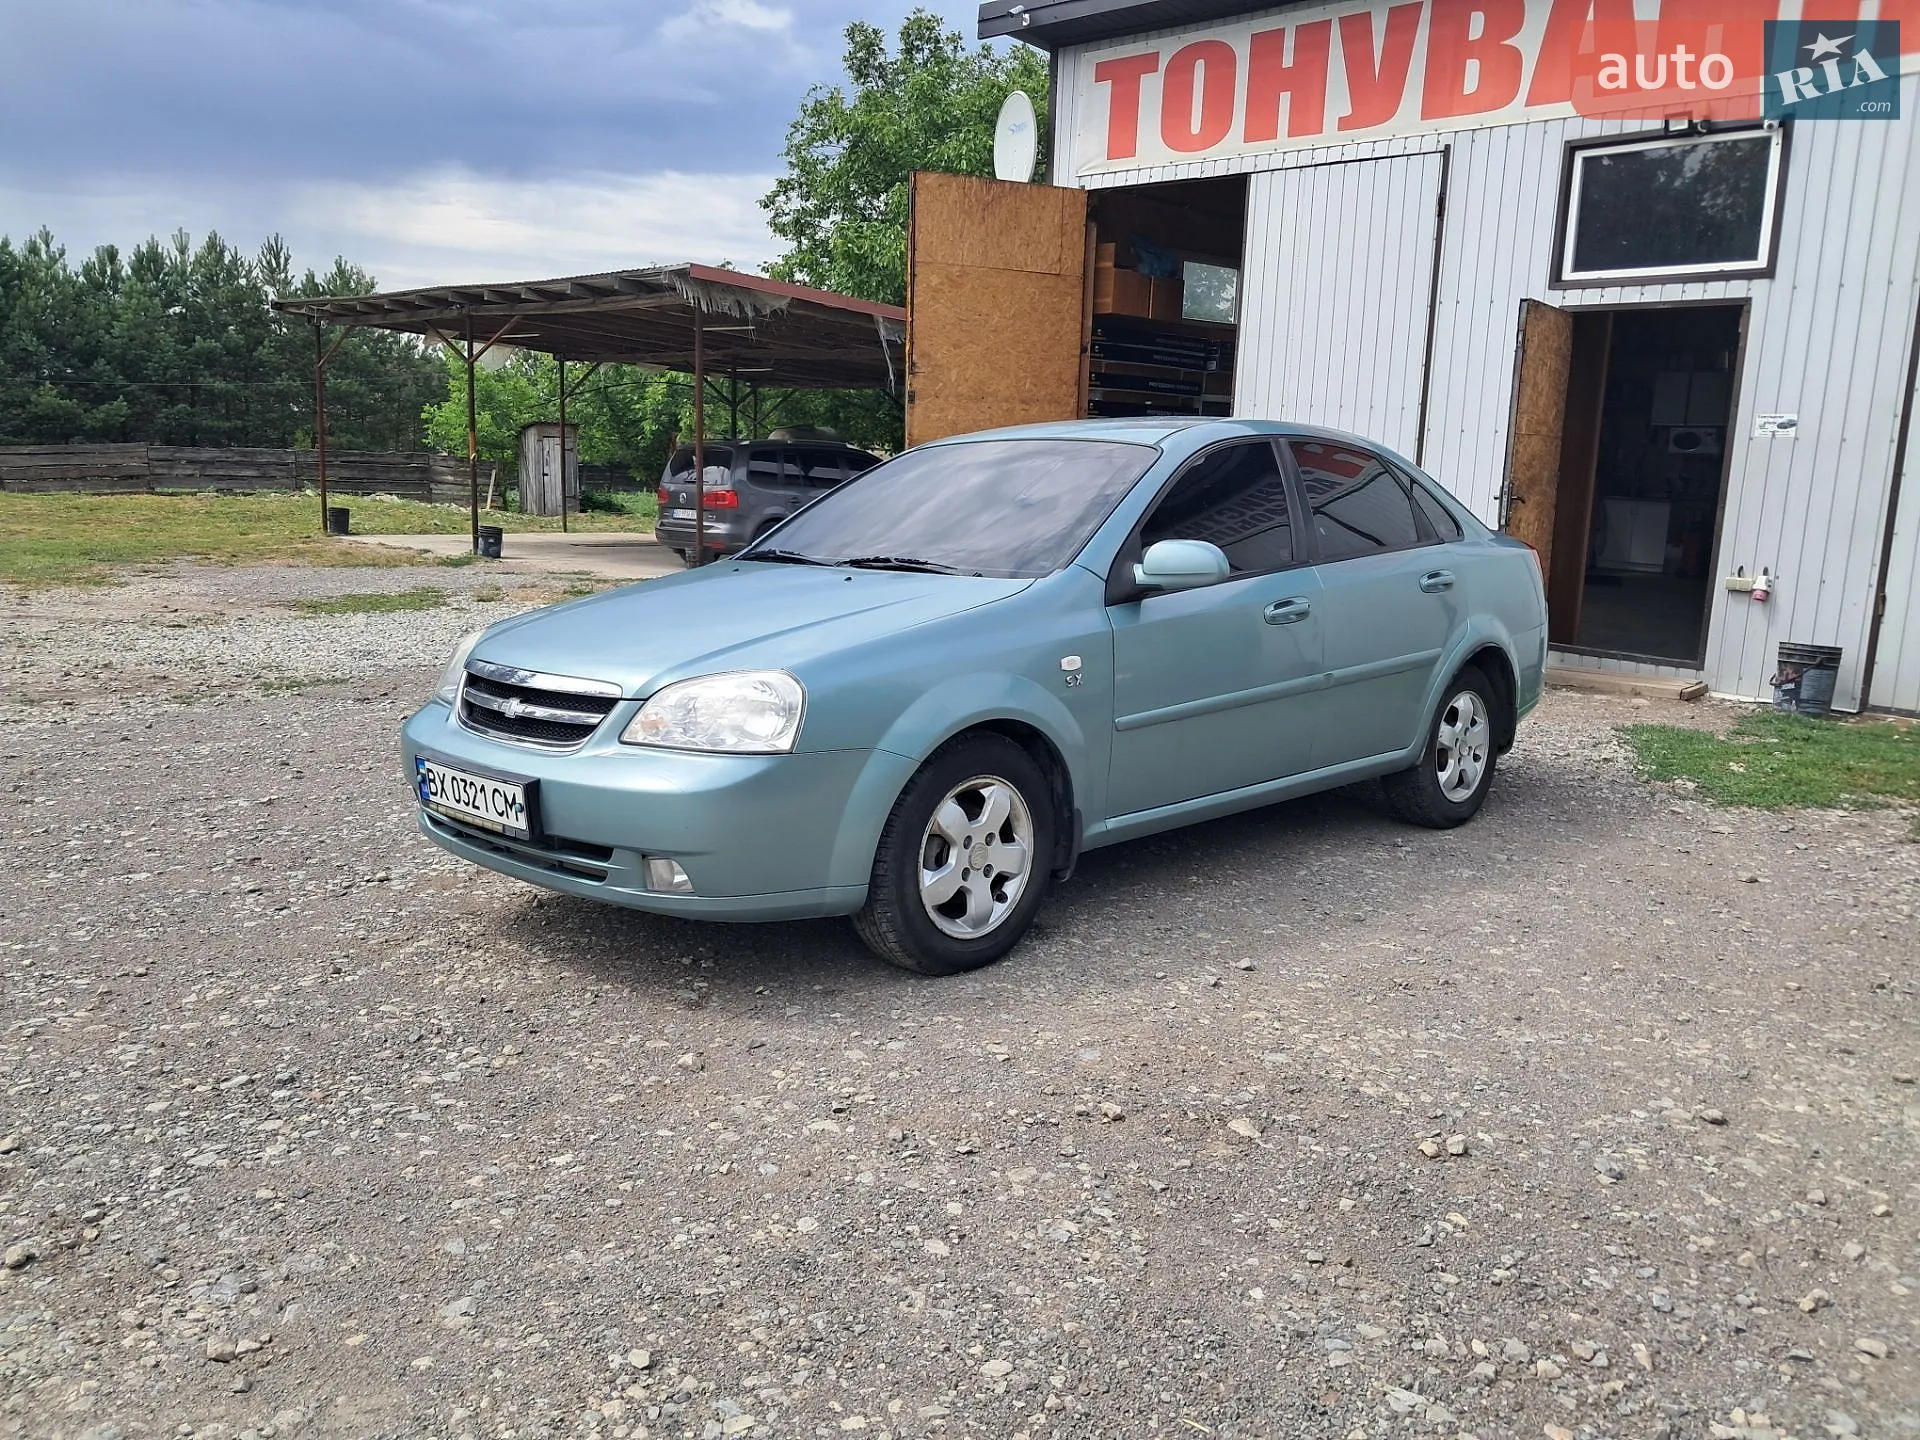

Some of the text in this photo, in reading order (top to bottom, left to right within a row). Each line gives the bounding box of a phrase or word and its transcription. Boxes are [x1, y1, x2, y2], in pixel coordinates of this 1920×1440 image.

[426, 768, 519, 822] BX 0321 CM
